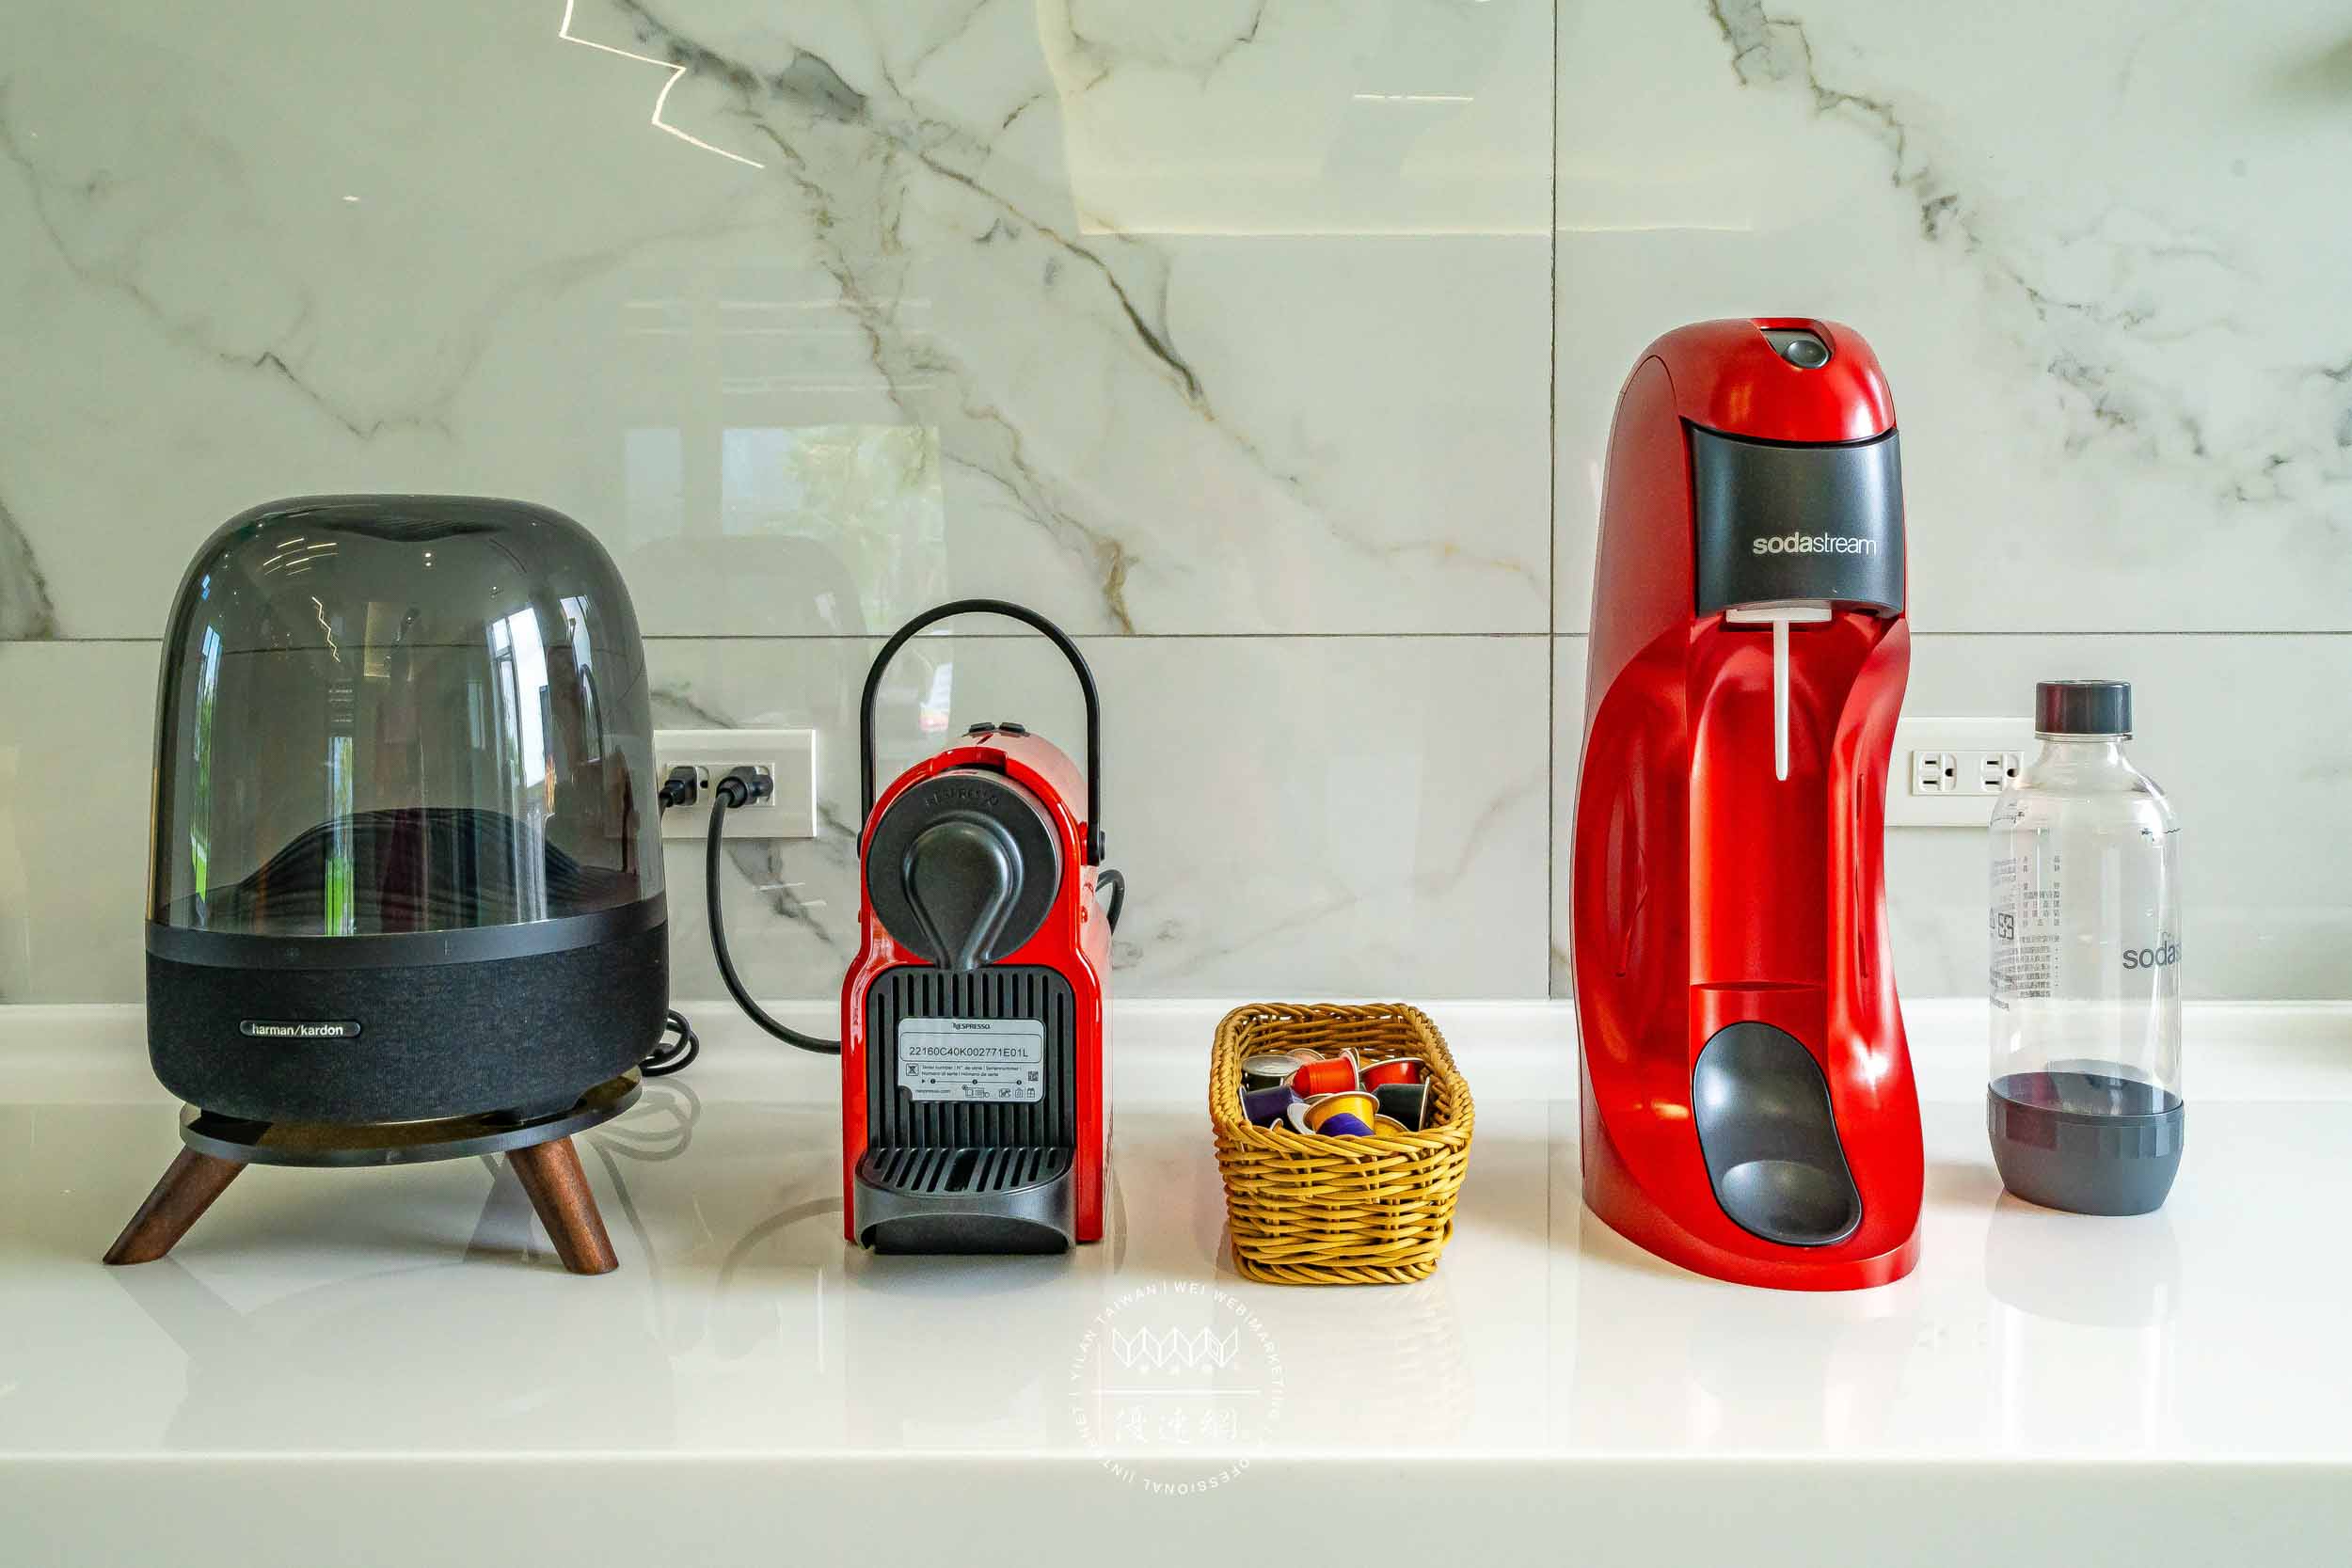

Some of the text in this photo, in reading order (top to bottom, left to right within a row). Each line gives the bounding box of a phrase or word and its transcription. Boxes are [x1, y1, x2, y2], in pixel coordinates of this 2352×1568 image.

[1753, 531, 1877, 555] sodastream
[252, 1022, 343, 1037] harman/kardon
[953, 1022, 991, 1031] NESPRESSO
[909, 1046, 1029, 1058] 22160C40K002771E01L
